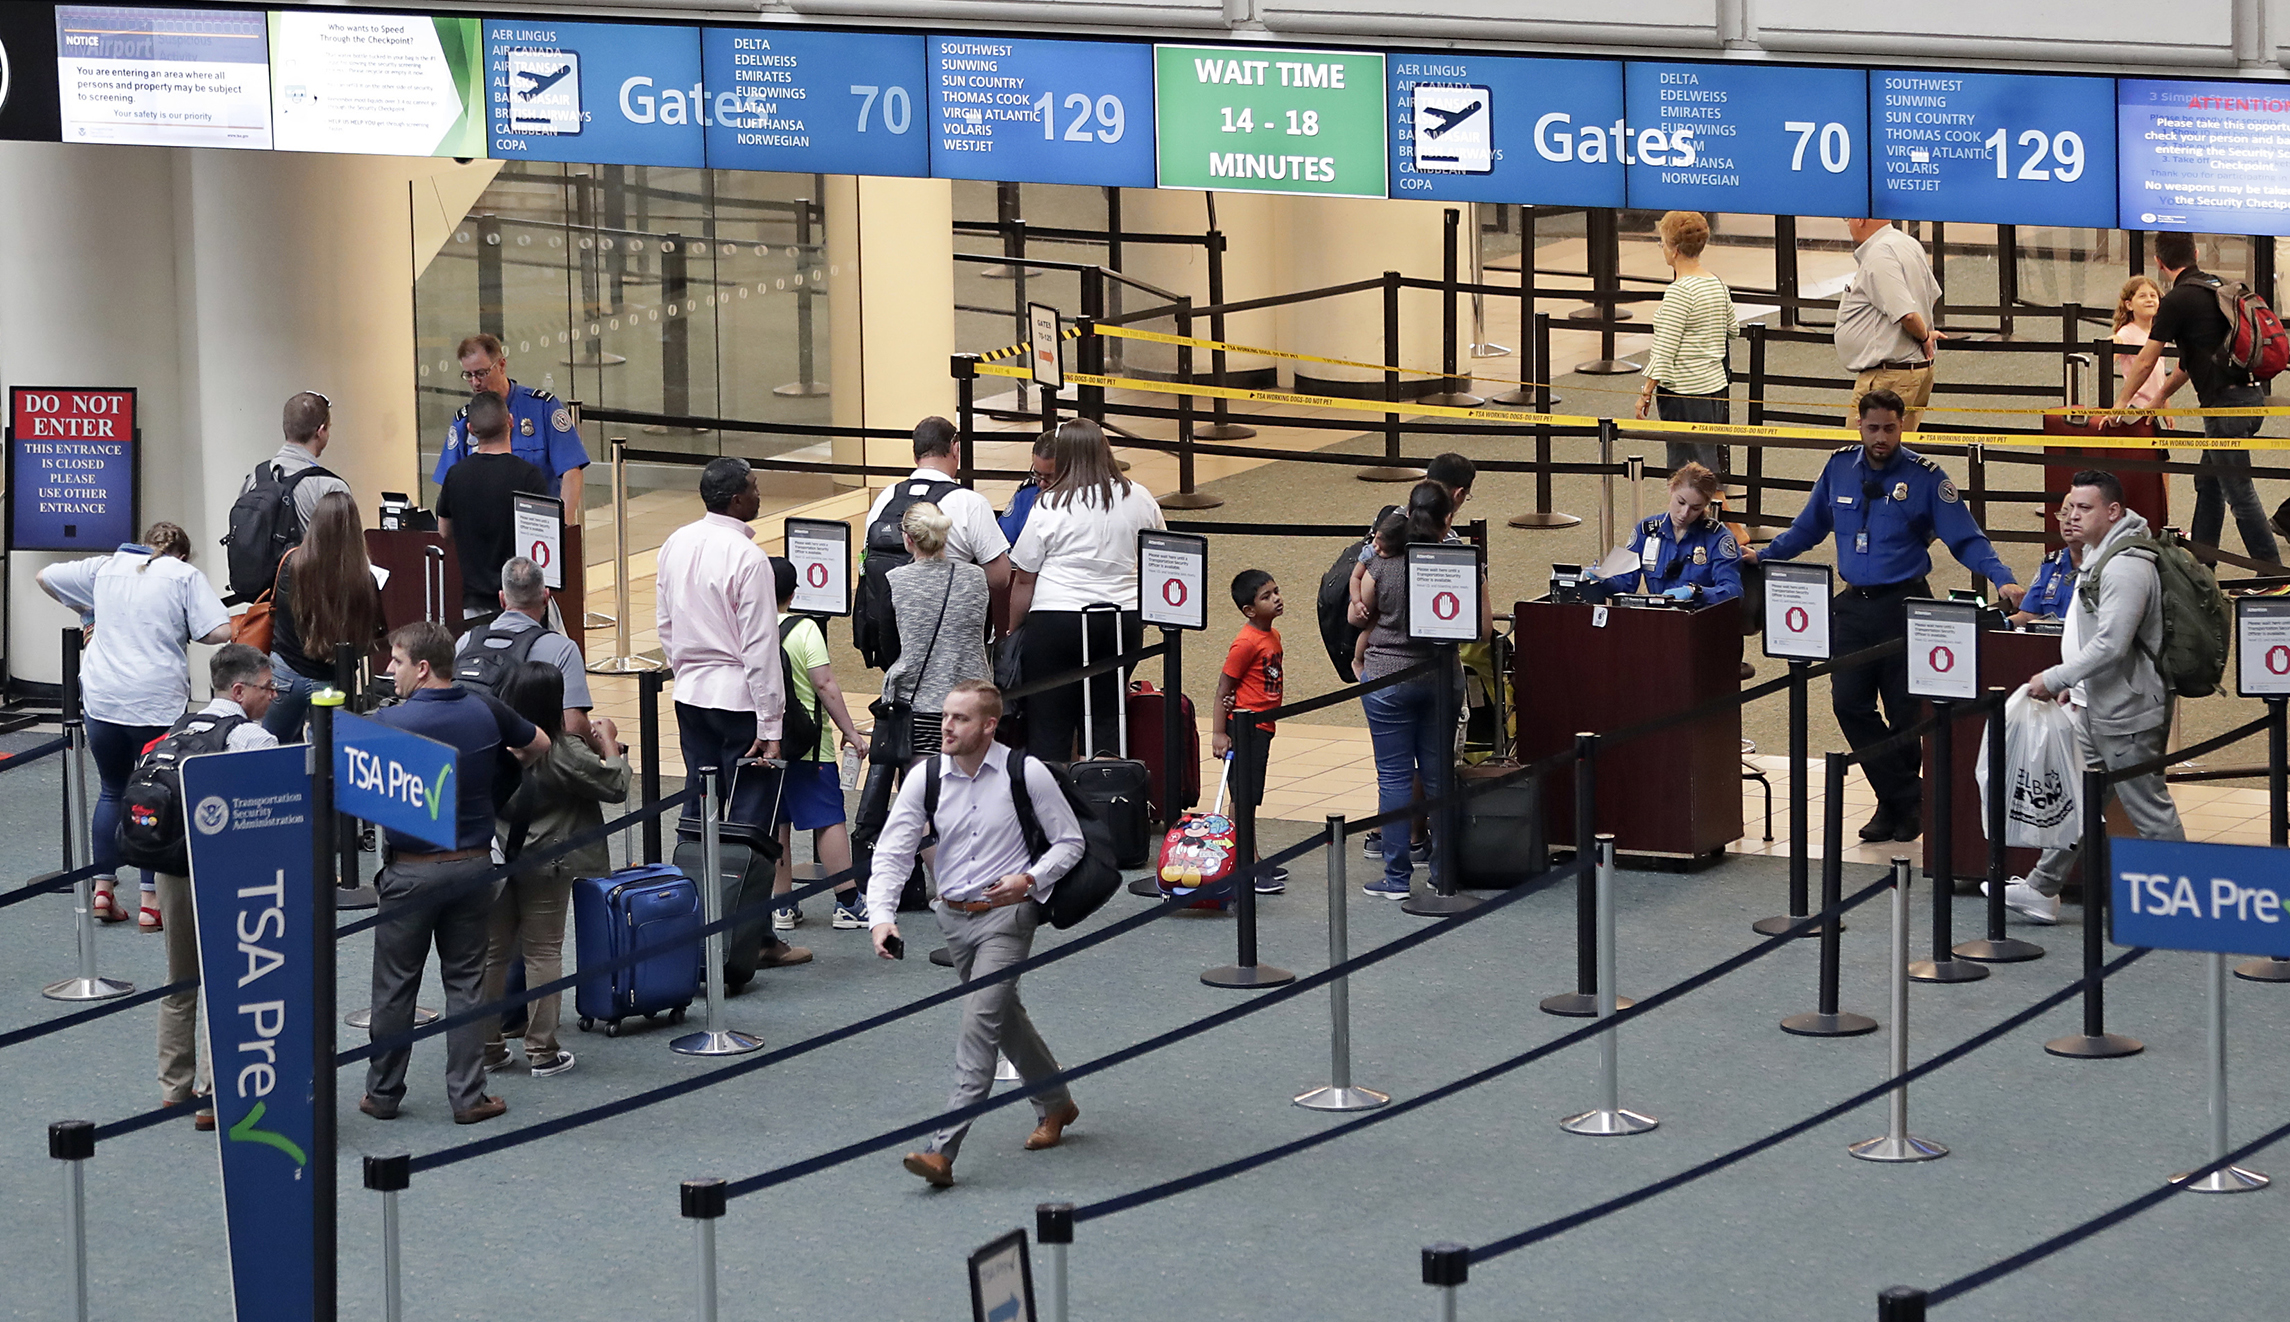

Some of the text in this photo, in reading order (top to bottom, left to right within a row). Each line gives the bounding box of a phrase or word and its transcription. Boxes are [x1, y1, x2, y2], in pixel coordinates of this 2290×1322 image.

[328, 24, 345, 32] Who
[382, 26, 404, 34] Speed
[492, 29, 557, 42] AER LINGUS
[66, 36, 99, 46] NOTICE
[320, 35, 351, 44] Through
[368, 36, 413, 45] Checkpoint?
[735, 38, 770, 50] DELTA
[493, 45, 562, 58] AIR CANADA
[942, 43, 1013, 56] SOUTHWEST
[493, 61, 566, 74] AIR TRANSAT
[735, 55, 797, 67] EDELWEISS
[942, 59, 998, 72] SUNWING
[77, 67, 93, 75] You
[112, 69, 149, 79] entering
[151, 70, 162, 78] an
[186, 70, 212, 79] where
[736, 70, 792, 83] EMIRATES
[1195, 59, 1345, 89] WAIT TIME
[1397, 64, 1466, 77] AER LINGUS
[494, 77, 539, 88] ALASKA
[942, 75, 1024, 89] SUN COUNTRY
[1660, 73, 1699, 85] DELTA
[1886, 78, 1963, 92] SOUTHWEST
[78, 81, 241, 94] persons and property may be subject
[736, 86, 806, 99] EUROWINGS
[1398, 81, 1416, 92] AIR
[90, 94, 136, 104] screening.
[495, 93, 570, 106] BAHAMASAIR
[619, 76, 768, 128] Gates
[943, 92, 1030, 105] THOMAS COOK
[1398, 97, 1416, 108] AIR
[1661, 90, 1728, 103] EDELWEISS
[1886, 95, 1946, 108] SUNWING
[737, 102, 777, 114] LATAM
[851, 85, 911, 135] 70
[943, 107, 1041, 122] VIRGIN ATLANTIC
[1661, 106, 1721, 119] EMIRATES
[114, 110, 131, 118] Your
[134, 110, 158, 120] safety
[160, 111, 166, 119] is
[185, 112, 212, 121] priority
[495, 108, 592, 123] BRITISH AIRWAYS
[1034, 92, 1125, 144] 129
[1221, 107, 1254, 133] 14
[1286, 110, 1319, 136] 18
[1886, 112, 1976, 126] SUN COUNTRY
[496, 124, 558, 136] CARIBBEAN
[737, 118, 805, 131] LUFTHANSA
[944, 123, 992, 136] VOLARIS
[1662, 123, 1737, 137] EUROWINGS
[2157, 118, 2193, 128] Please
[2196, 120, 2220, 129] take
[2224, 121, 2245, 130] this
[738, 134, 810, 147] NORWEGIAN
[1534, 112, 1695, 167] Gates
[1886, 128, 1981, 142] THOMAS COOK
[2145, 132, 2177, 141] check
[2181, 134, 2206, 143] your
[2209, 135, 2248, 144] person
[2252, 135, 2273, 145] and
[497, 140, 527, 151] COPA
[944, 139, 993, 152] WESTJET
[1785, 121, 1850, 173] 70
[1447, 148, 1503, 161] AIRWAYS
[1932, 147, 1993, 160] ATLANTIC
[1985, 128, 2085, 182] 129
[2156, 147, 2203, 157] entering
[2207, 148, 2226, 156] the
[2228, 149, 2275, 159] Security
[1210, 152, 1335, 182] MINUTES
[1887, 162, 1939, 175] VOLARIS
[2210, 161, 2278, 172] Checkpoint.
[1400, 179, 1433, 190] COPA
[1662, 173, 1739, 186] NORWEGIAN
[1887, 179, 1941, 191] WESTJET
[2145, 181, 2162, 190] No
[2165, 183, 2216, 194] weapons
[2219, 185, 2242, 195] may
[2246, 185, 2261, 194] be
[2175, 195, 2195, 205] the
[2197, 196, 2243, 208] Security
[1037, 320, 1051, 329] GATES
[25, 395, 123, 414] DO NOT
[34, 418, 115, 437] ENTER
[25, 444, 122, 455] THIS ENTRANCE
[42, 459, 105, 470] IS CLOSED
[51, 474, 96, 484] PLEASE
[39, 488, 107, 499] USE OTHER
[40, 503, 106, 514] ENTRANCE
[345, 746, 424, 807] TSA Pre
[232, 793, 302, 809] Transportation
[233, 807, 273, 820] Security
[232, 815, 304, 831] Administration
[2120, 872, 2280, 923] TSA Pre
[237, 869, 285, 1098] TSA Pre
